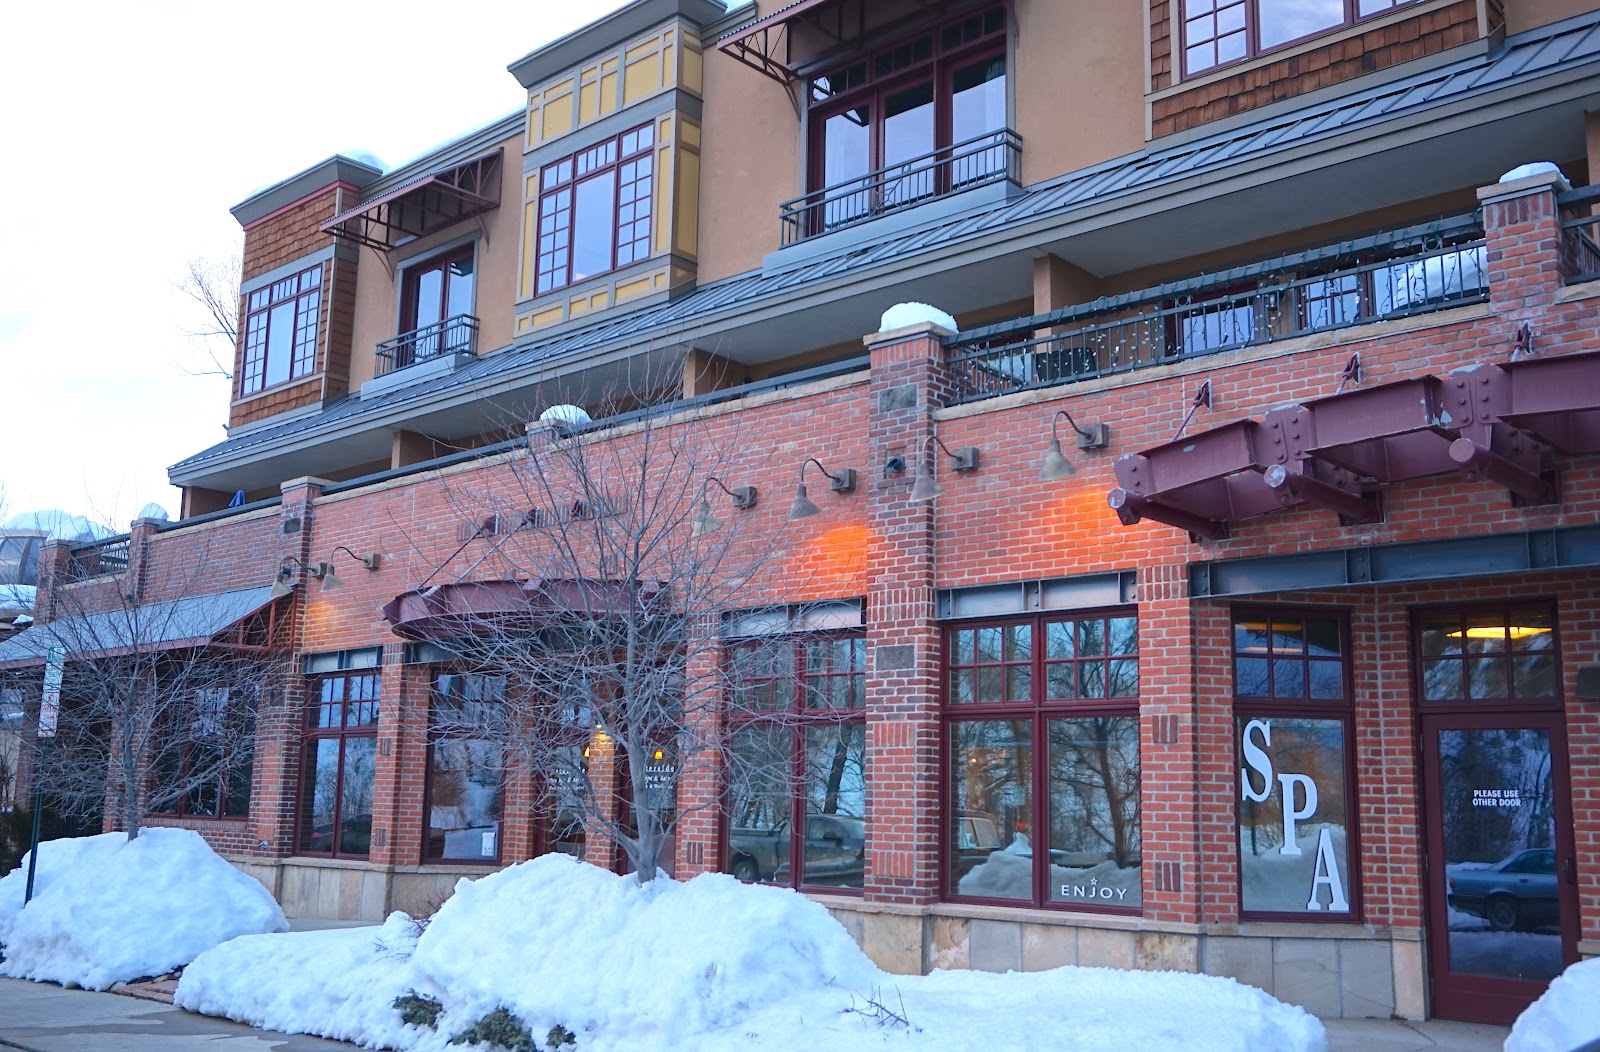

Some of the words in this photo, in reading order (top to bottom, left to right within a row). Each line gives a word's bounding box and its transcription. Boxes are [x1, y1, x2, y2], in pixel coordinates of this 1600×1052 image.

[645, 764, 675, 773] terside
[1473, 789, 1502, 798] PLEASE
[1503, 789, 1520, 798] USE
[1472, 798, 1498, 807] OTHER
[1499, 799, 1522, 807] DOOR
[1061, 884, 1127, 900] ENJOY
